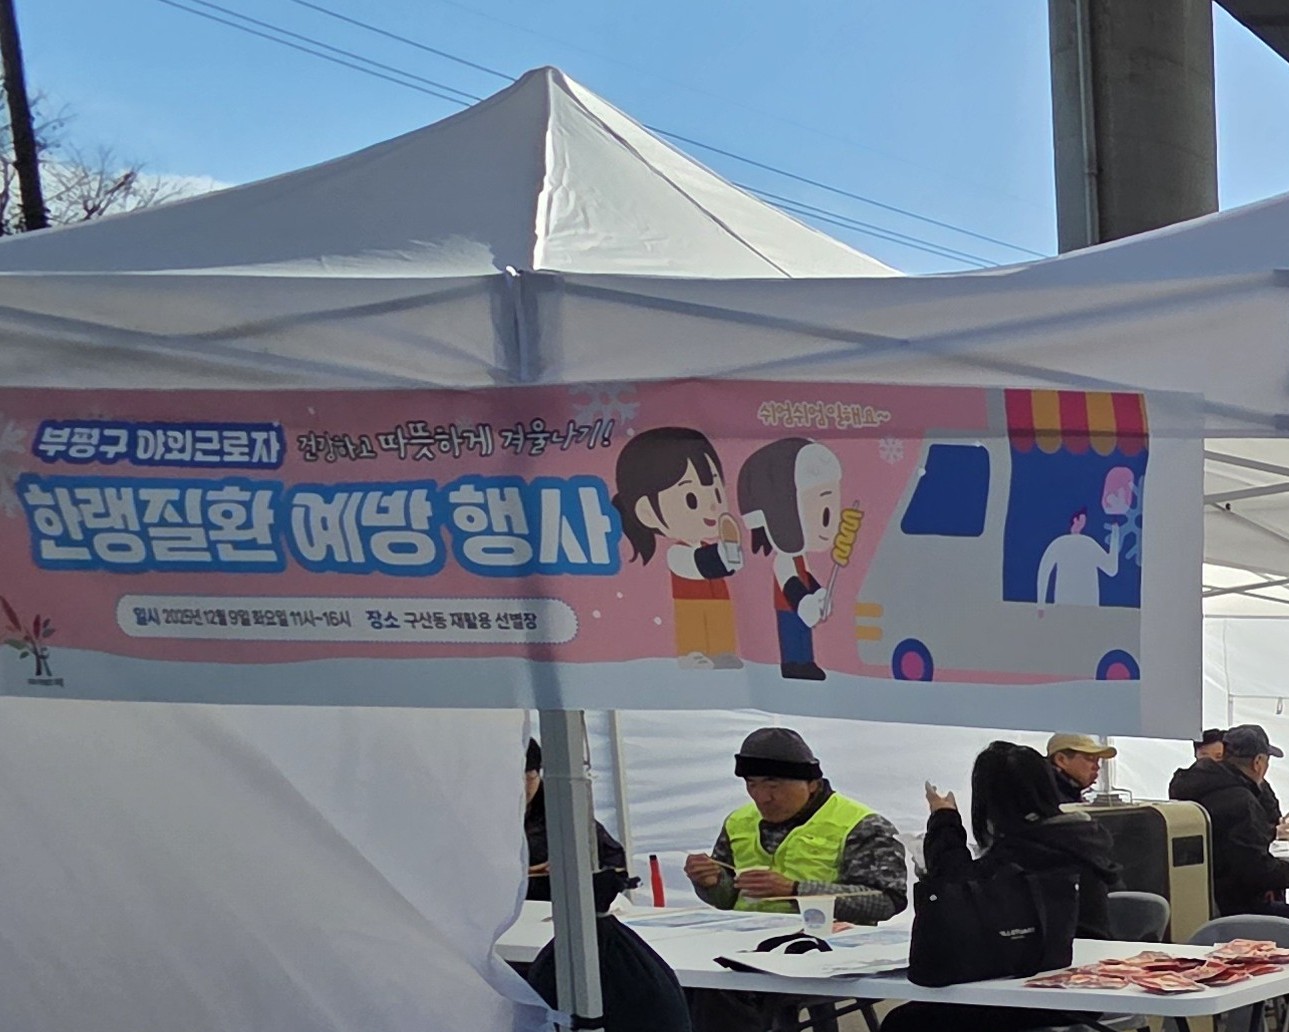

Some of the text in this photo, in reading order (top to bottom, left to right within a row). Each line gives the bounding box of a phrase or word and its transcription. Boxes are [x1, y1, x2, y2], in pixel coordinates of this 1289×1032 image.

[38, 418, 615, 463] 부평구 야외근로자 건강하고 따뜻하게 겨울나기!
[23, 483, 613, 567] 한랭질환 예방 행사
[132, 607, 161, 626] 일시
[228, 609, 251, 626] 9일
[365, 610, 401, 630] 장소
[404, 611, 448, 630] 구산동
